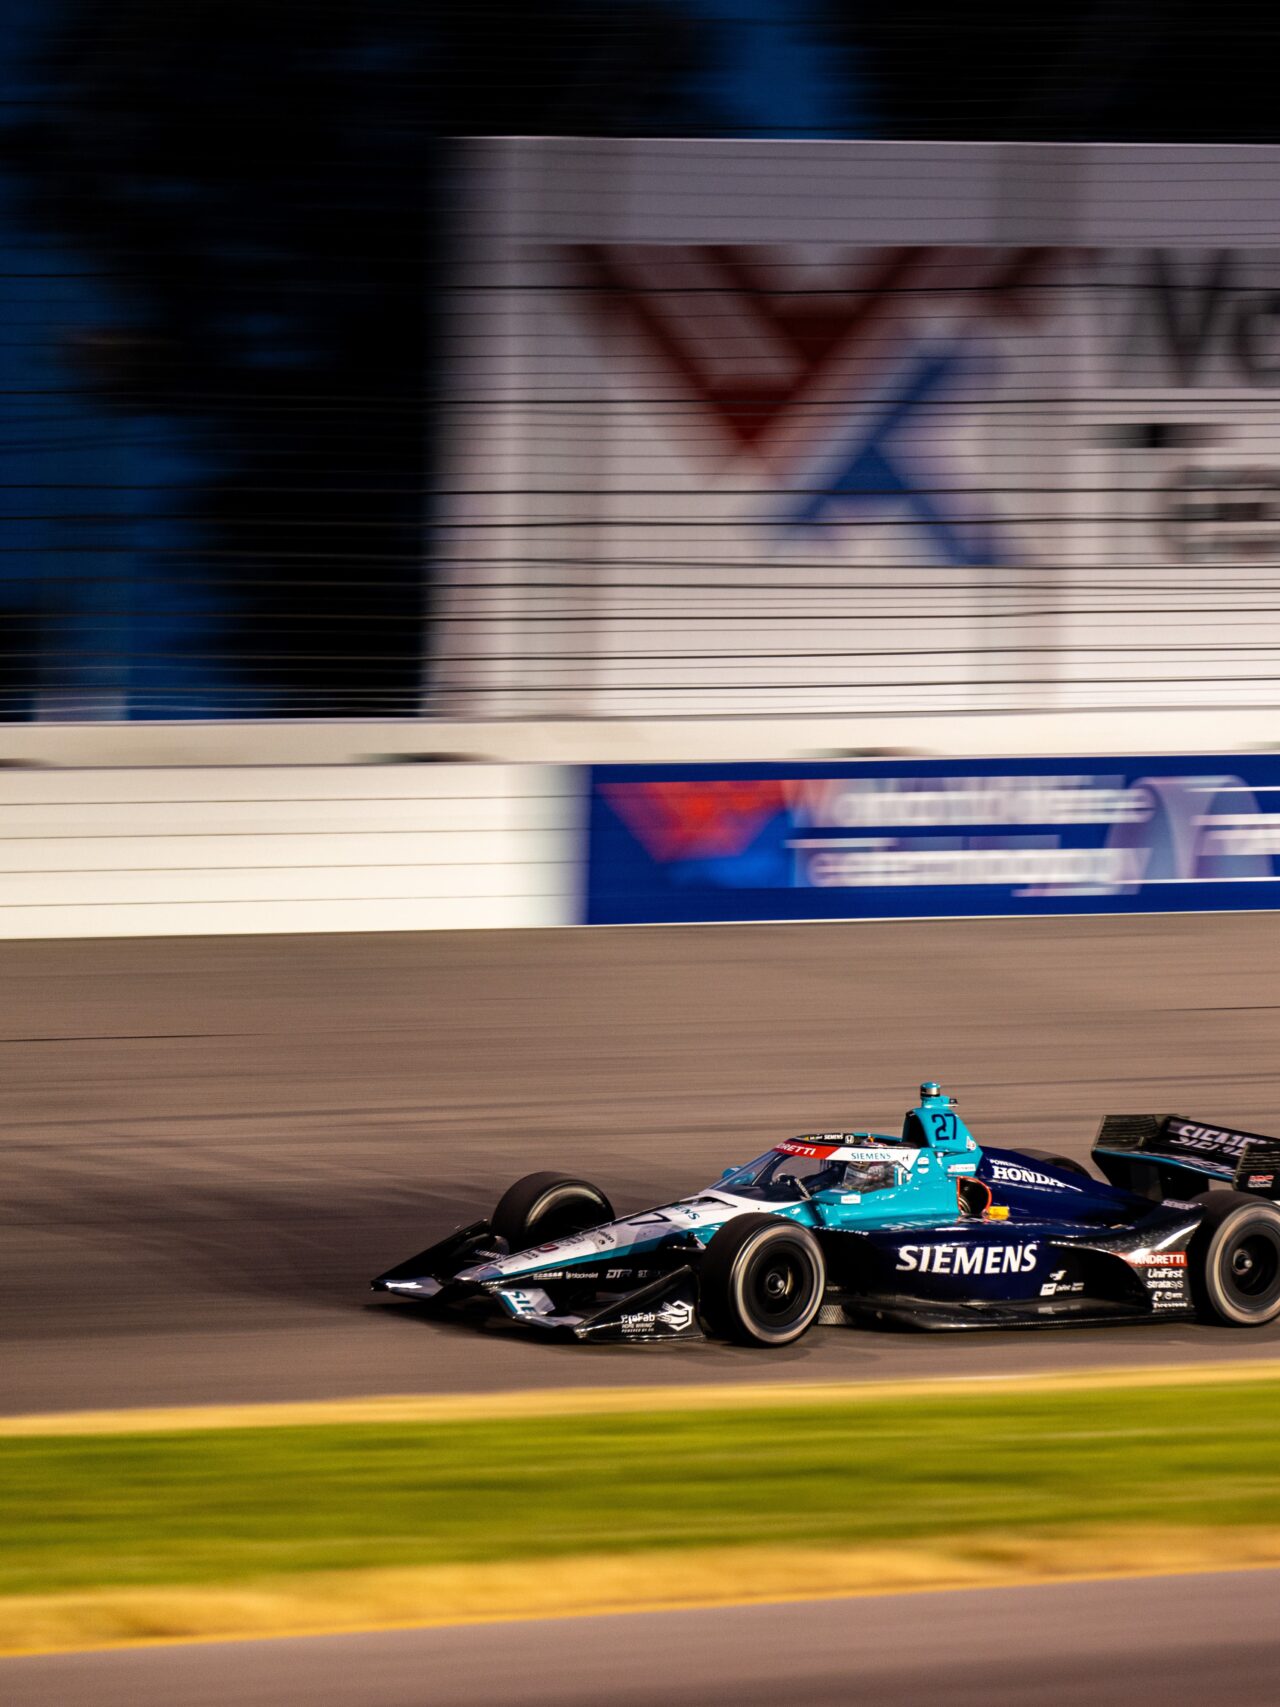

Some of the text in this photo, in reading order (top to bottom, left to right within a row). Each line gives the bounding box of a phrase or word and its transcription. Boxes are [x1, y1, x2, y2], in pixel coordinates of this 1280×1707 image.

[932, 1113, 957, 1141] 27
[851, 1152, 892, 1160] SIEMENS
[992, 1165, 1066, 1188] HONDA
[895, 1244, 1038, 1275] SIEMENS
[1135, 1254, 1185, 1265] ANDRETTI
[1147, 1268, 1184, 1279] UniFirst
[1147, 1281, 1184, 1290] stratasys
